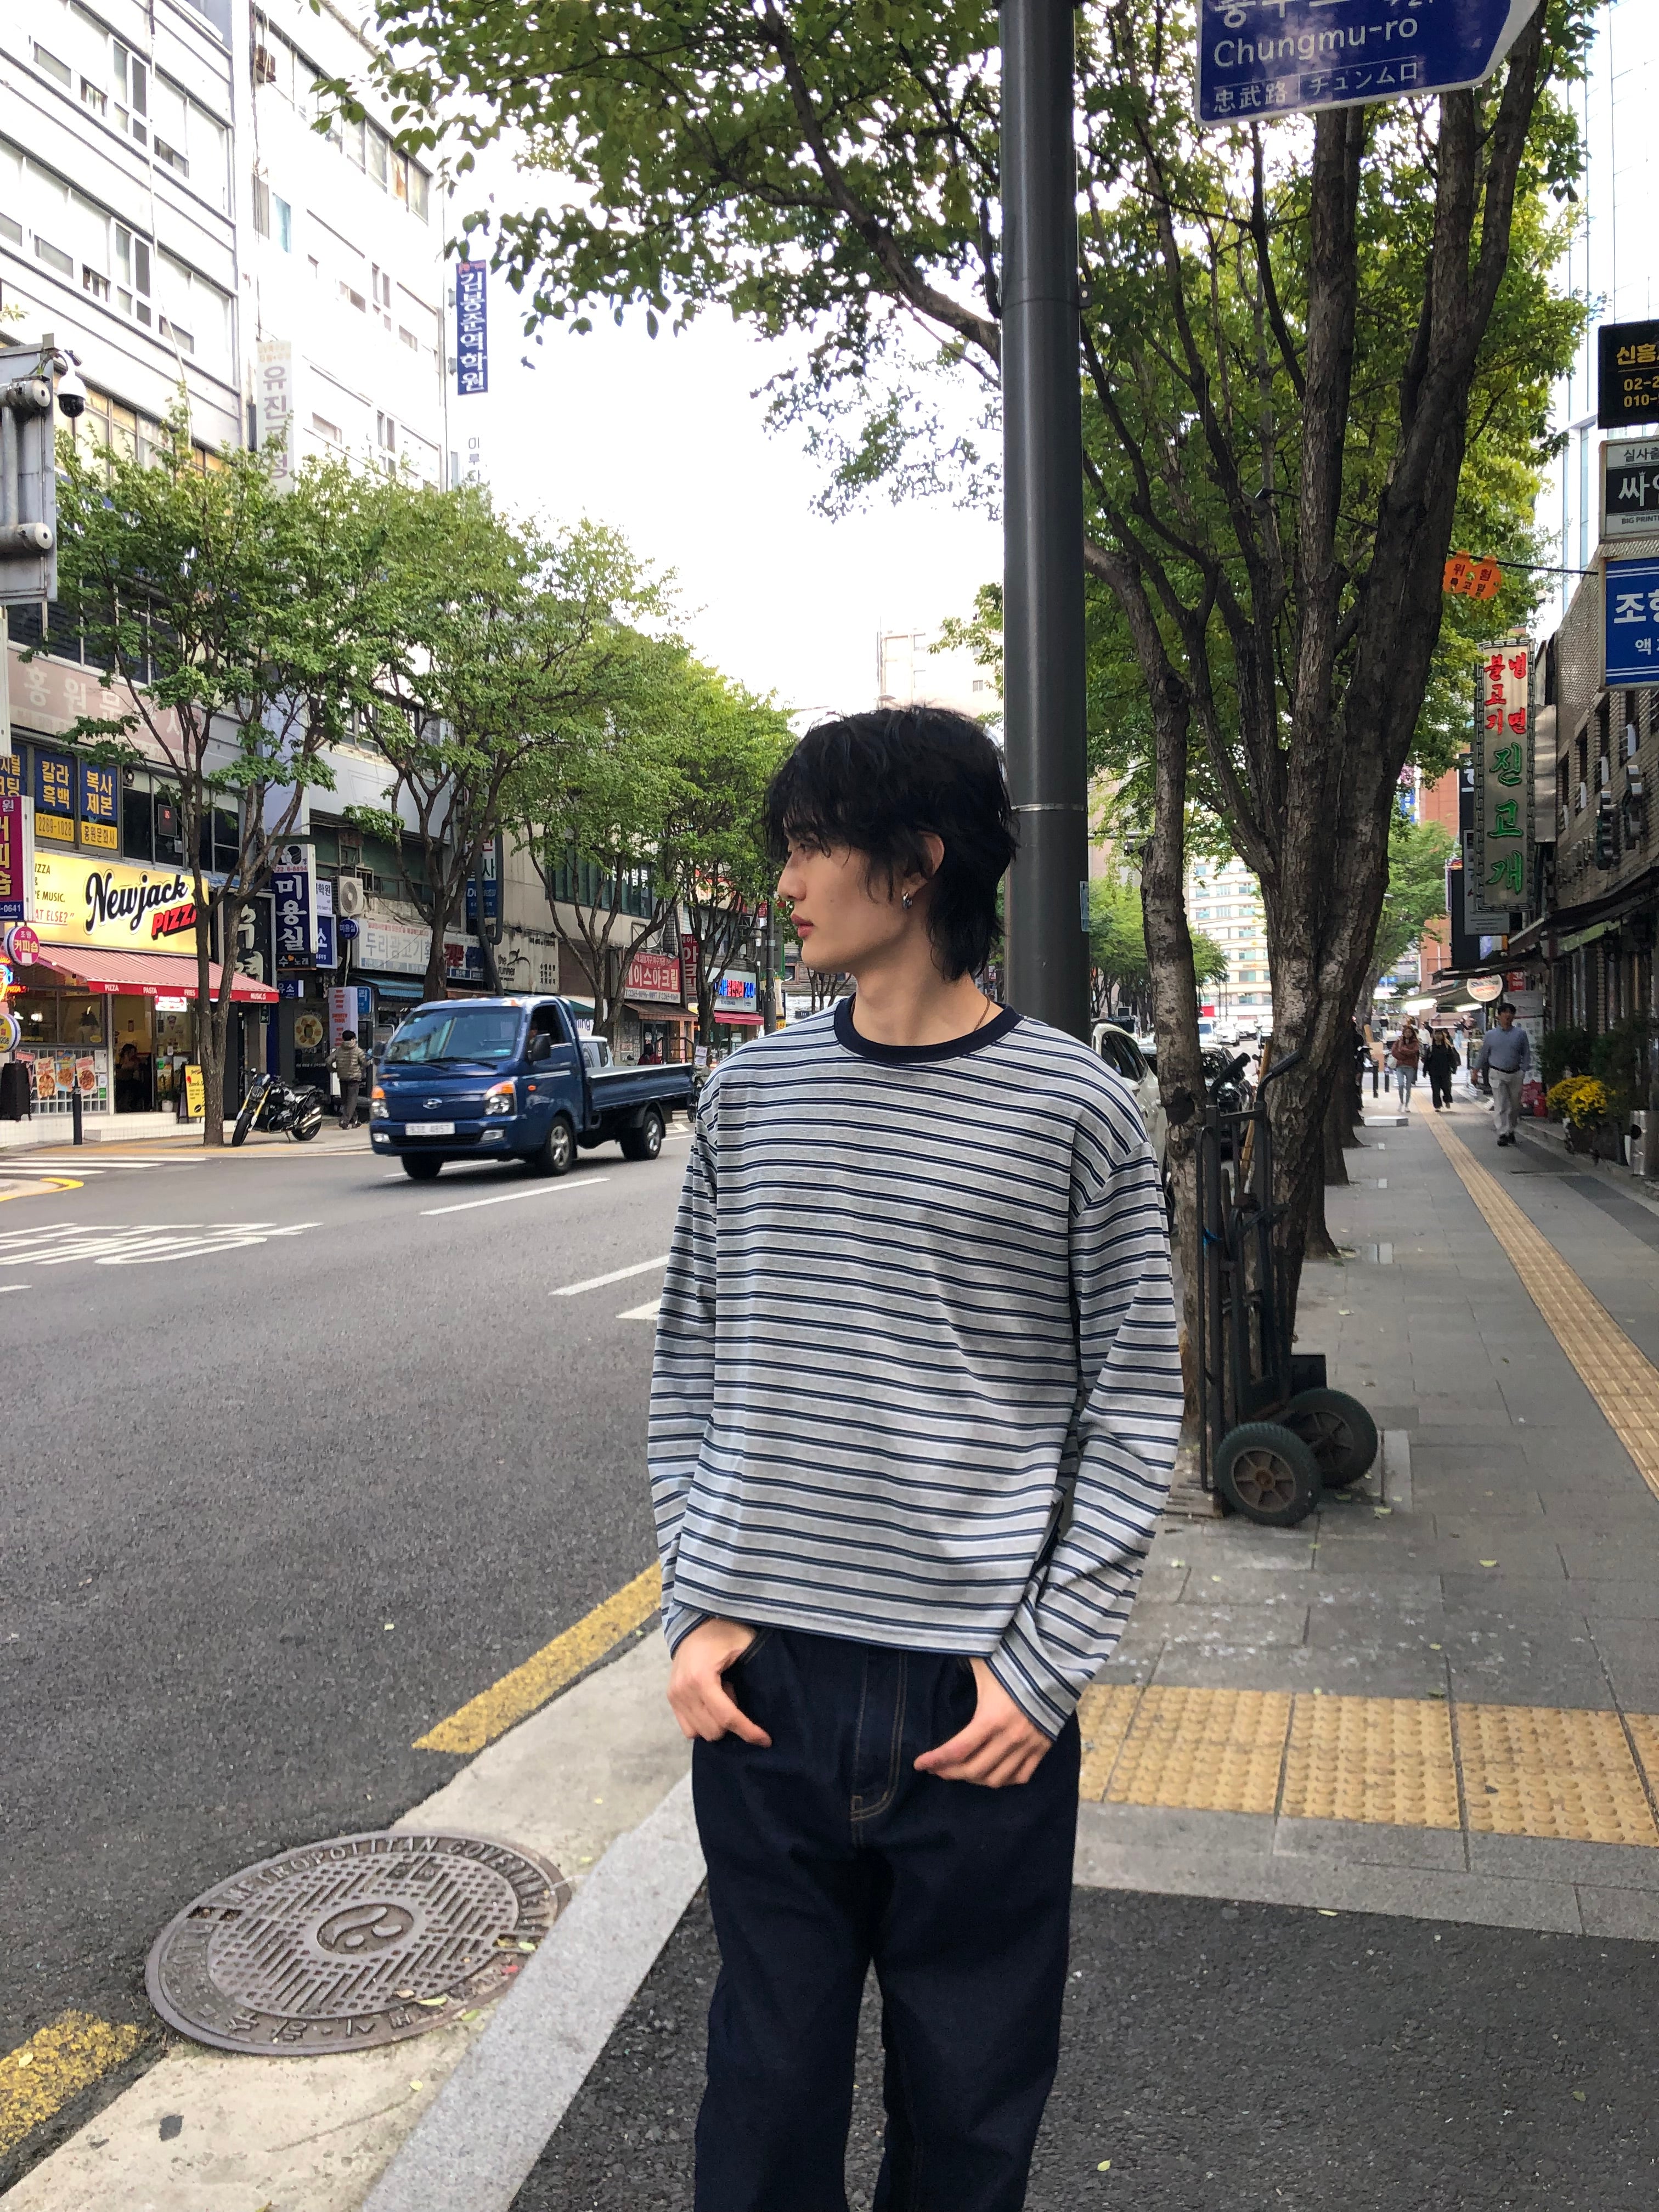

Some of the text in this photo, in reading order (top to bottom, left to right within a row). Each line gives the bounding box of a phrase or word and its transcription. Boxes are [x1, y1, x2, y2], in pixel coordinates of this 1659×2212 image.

[1214, 18, 1418, 67] Chungmu-ro
[1213, 82, 1287, 113] 忠武路
[1616, 343, 1659, 365] 신흥
[1624, 394, 1659, 408] 010-
[1484, 653, 1506, 736] 불고기
[1508, 652, 1527, 735] 냉면
[42, 761, 69, 786] 칼라
[87, 770, 113, 795] 복사
[43, 785, 70, 810] 흑백
[87, 793, 113, 816] 제본
[1486, 742, 1524, 896] 진고개
[35, 864, 50, 874] IZZA
[42, 891, 65, 902] MUSIC.
[86, 872, 188, 932] Newjack
[275, 874, 307, 951] 미용실
[14, 939, 38, 953] 커피숍
[104, 984, 120, 992] PIZZA
